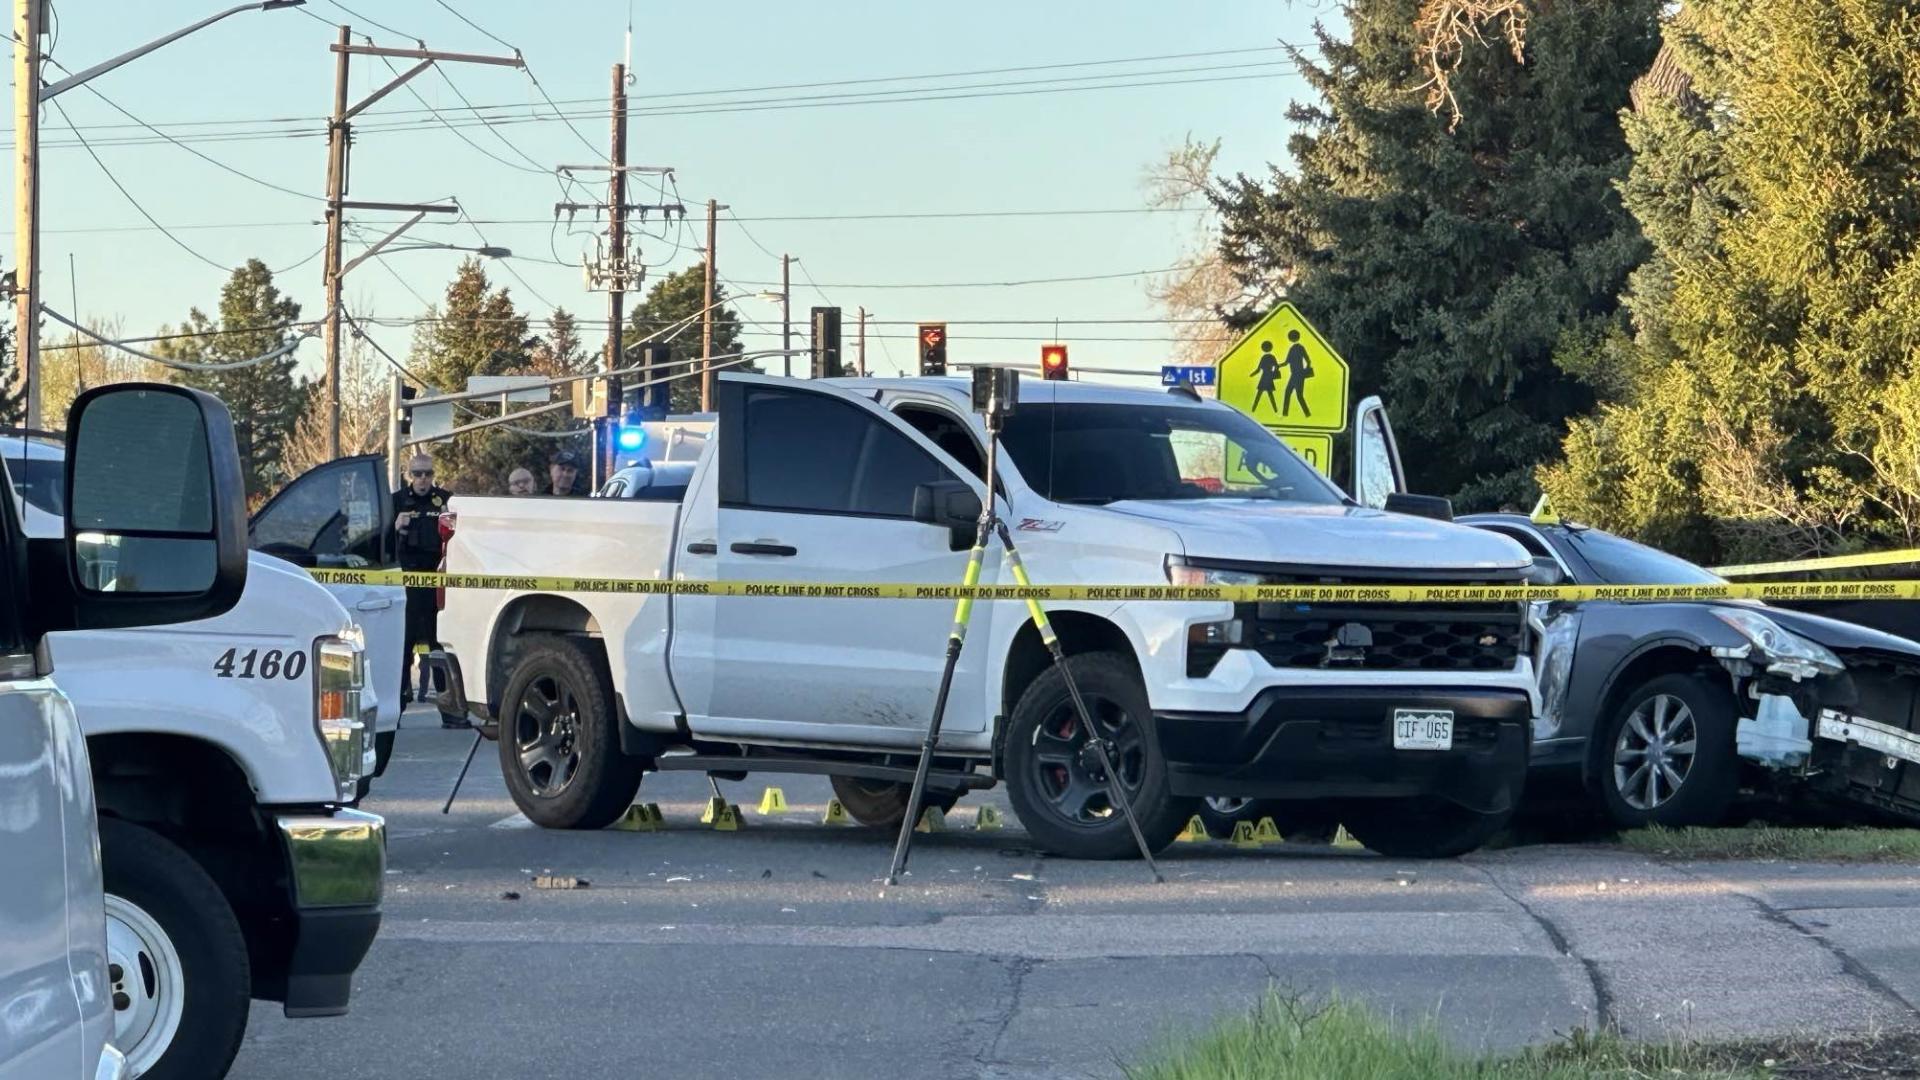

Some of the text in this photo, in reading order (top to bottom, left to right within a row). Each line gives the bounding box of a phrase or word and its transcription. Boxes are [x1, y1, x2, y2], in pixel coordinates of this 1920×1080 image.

[333, 572, 366, 584] CROSS
[403, 574, 538, 589] POLICE LINE DO NOT CROSS
[573, 582, 709, 593] POLICE LINE DO NOT CROSS
[745, 585, 880, 597] POLICE LINE DO NOT CROSS
[917, 588, 1050, 598] POLICE LINE DO NOT CROSS
[1087, 588, 1220, 598] POLICE LINE DO NOT CROSS
[1595, 587, 1727, 598] POLICE LINE DO NOT CROSS
[1763, 584, 1896, 596] POLICE LINE DO NOT CROSS
[1257, 589, 1390, 599] POLICE LINE DO NOT CROSS
[1426, 589, 1560, 599] POLICE LINE DO NOT CROSS
[213, 648, 307, 680] 4160
[833, 802, 841, 816] 3
[1242, 825, 1254, 840] 12
